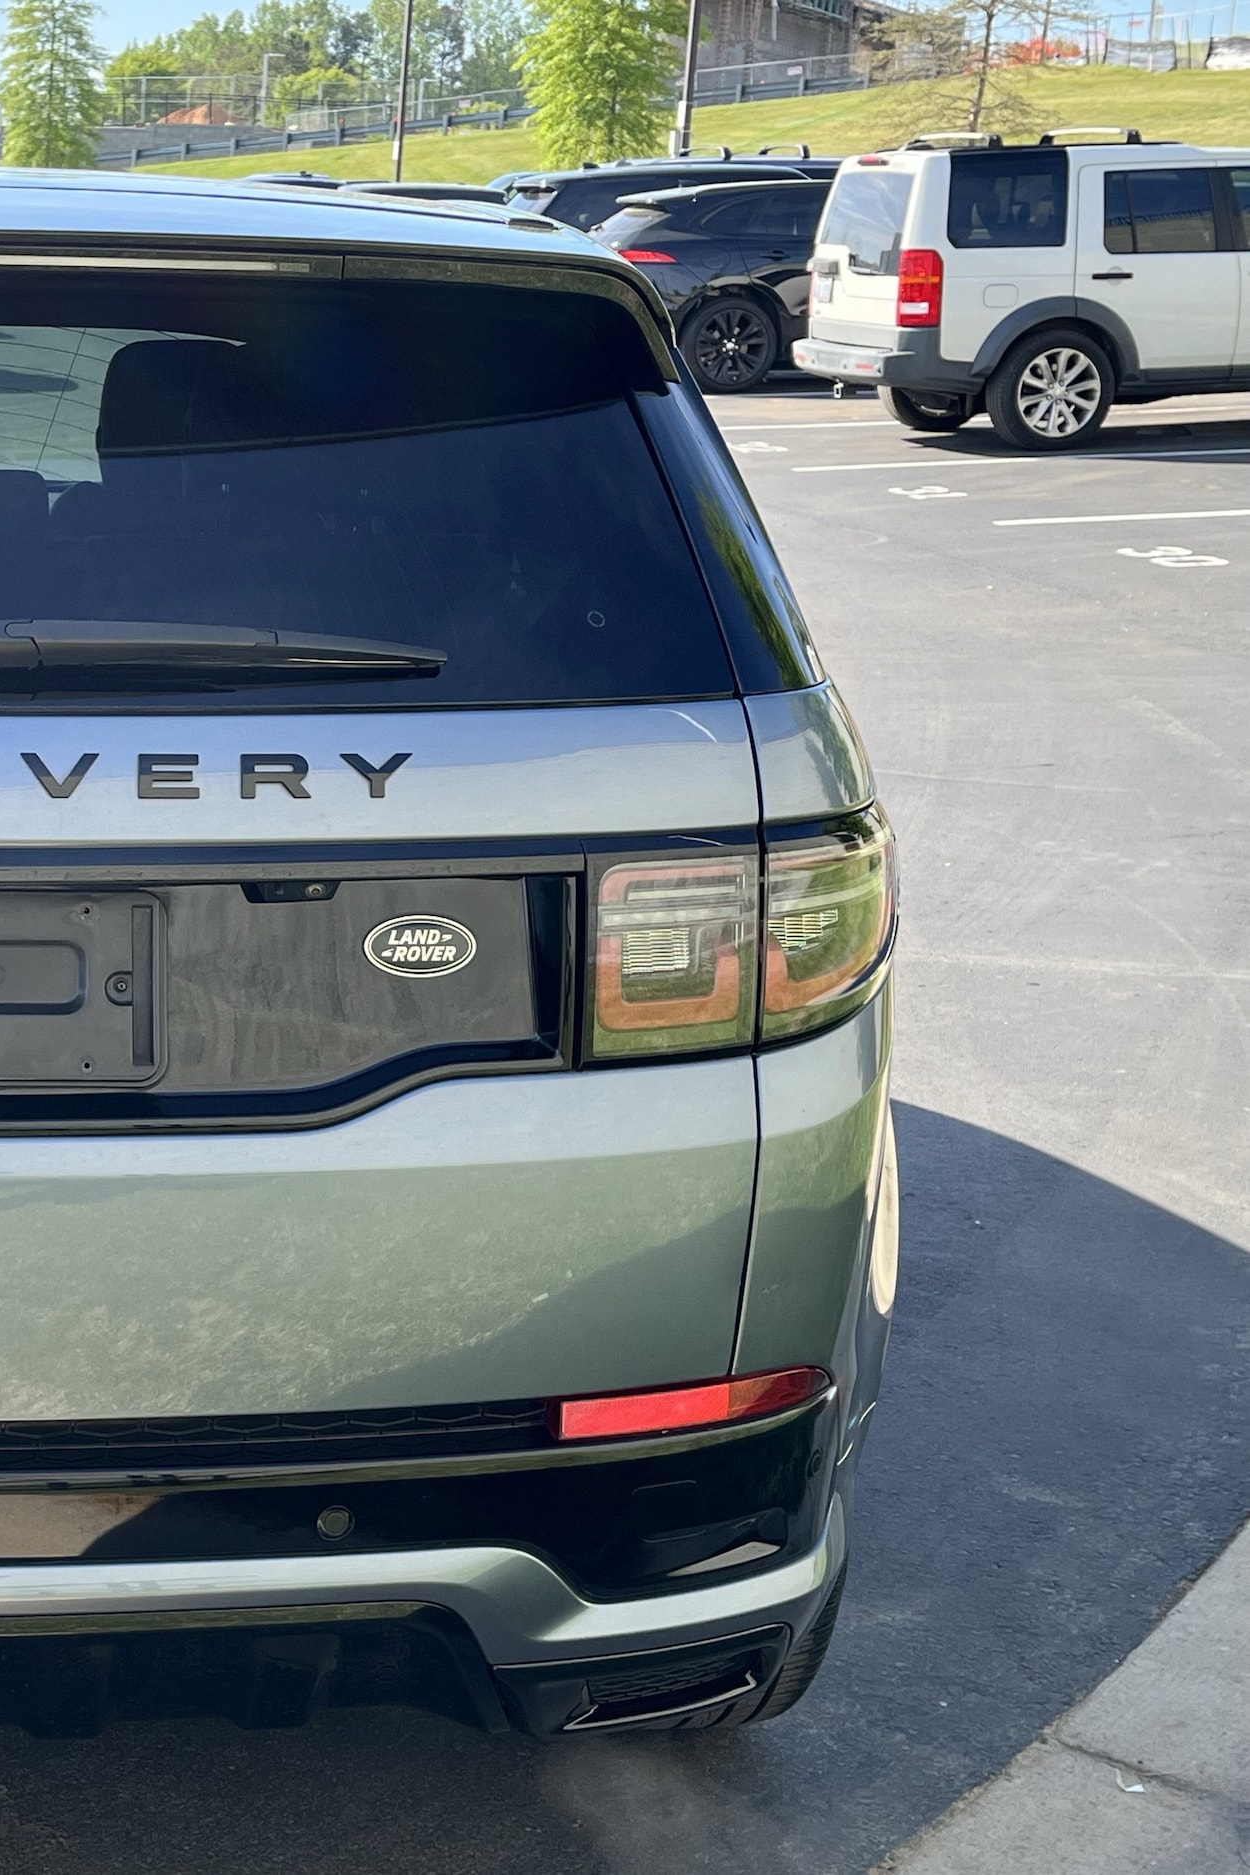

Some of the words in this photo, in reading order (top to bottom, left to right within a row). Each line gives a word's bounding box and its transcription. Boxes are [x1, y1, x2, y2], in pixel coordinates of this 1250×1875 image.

[1116, 545, 1229, 567] 30
[388, 929, 441, 945] LAND
[392, 945, 457, 962] ROVER
